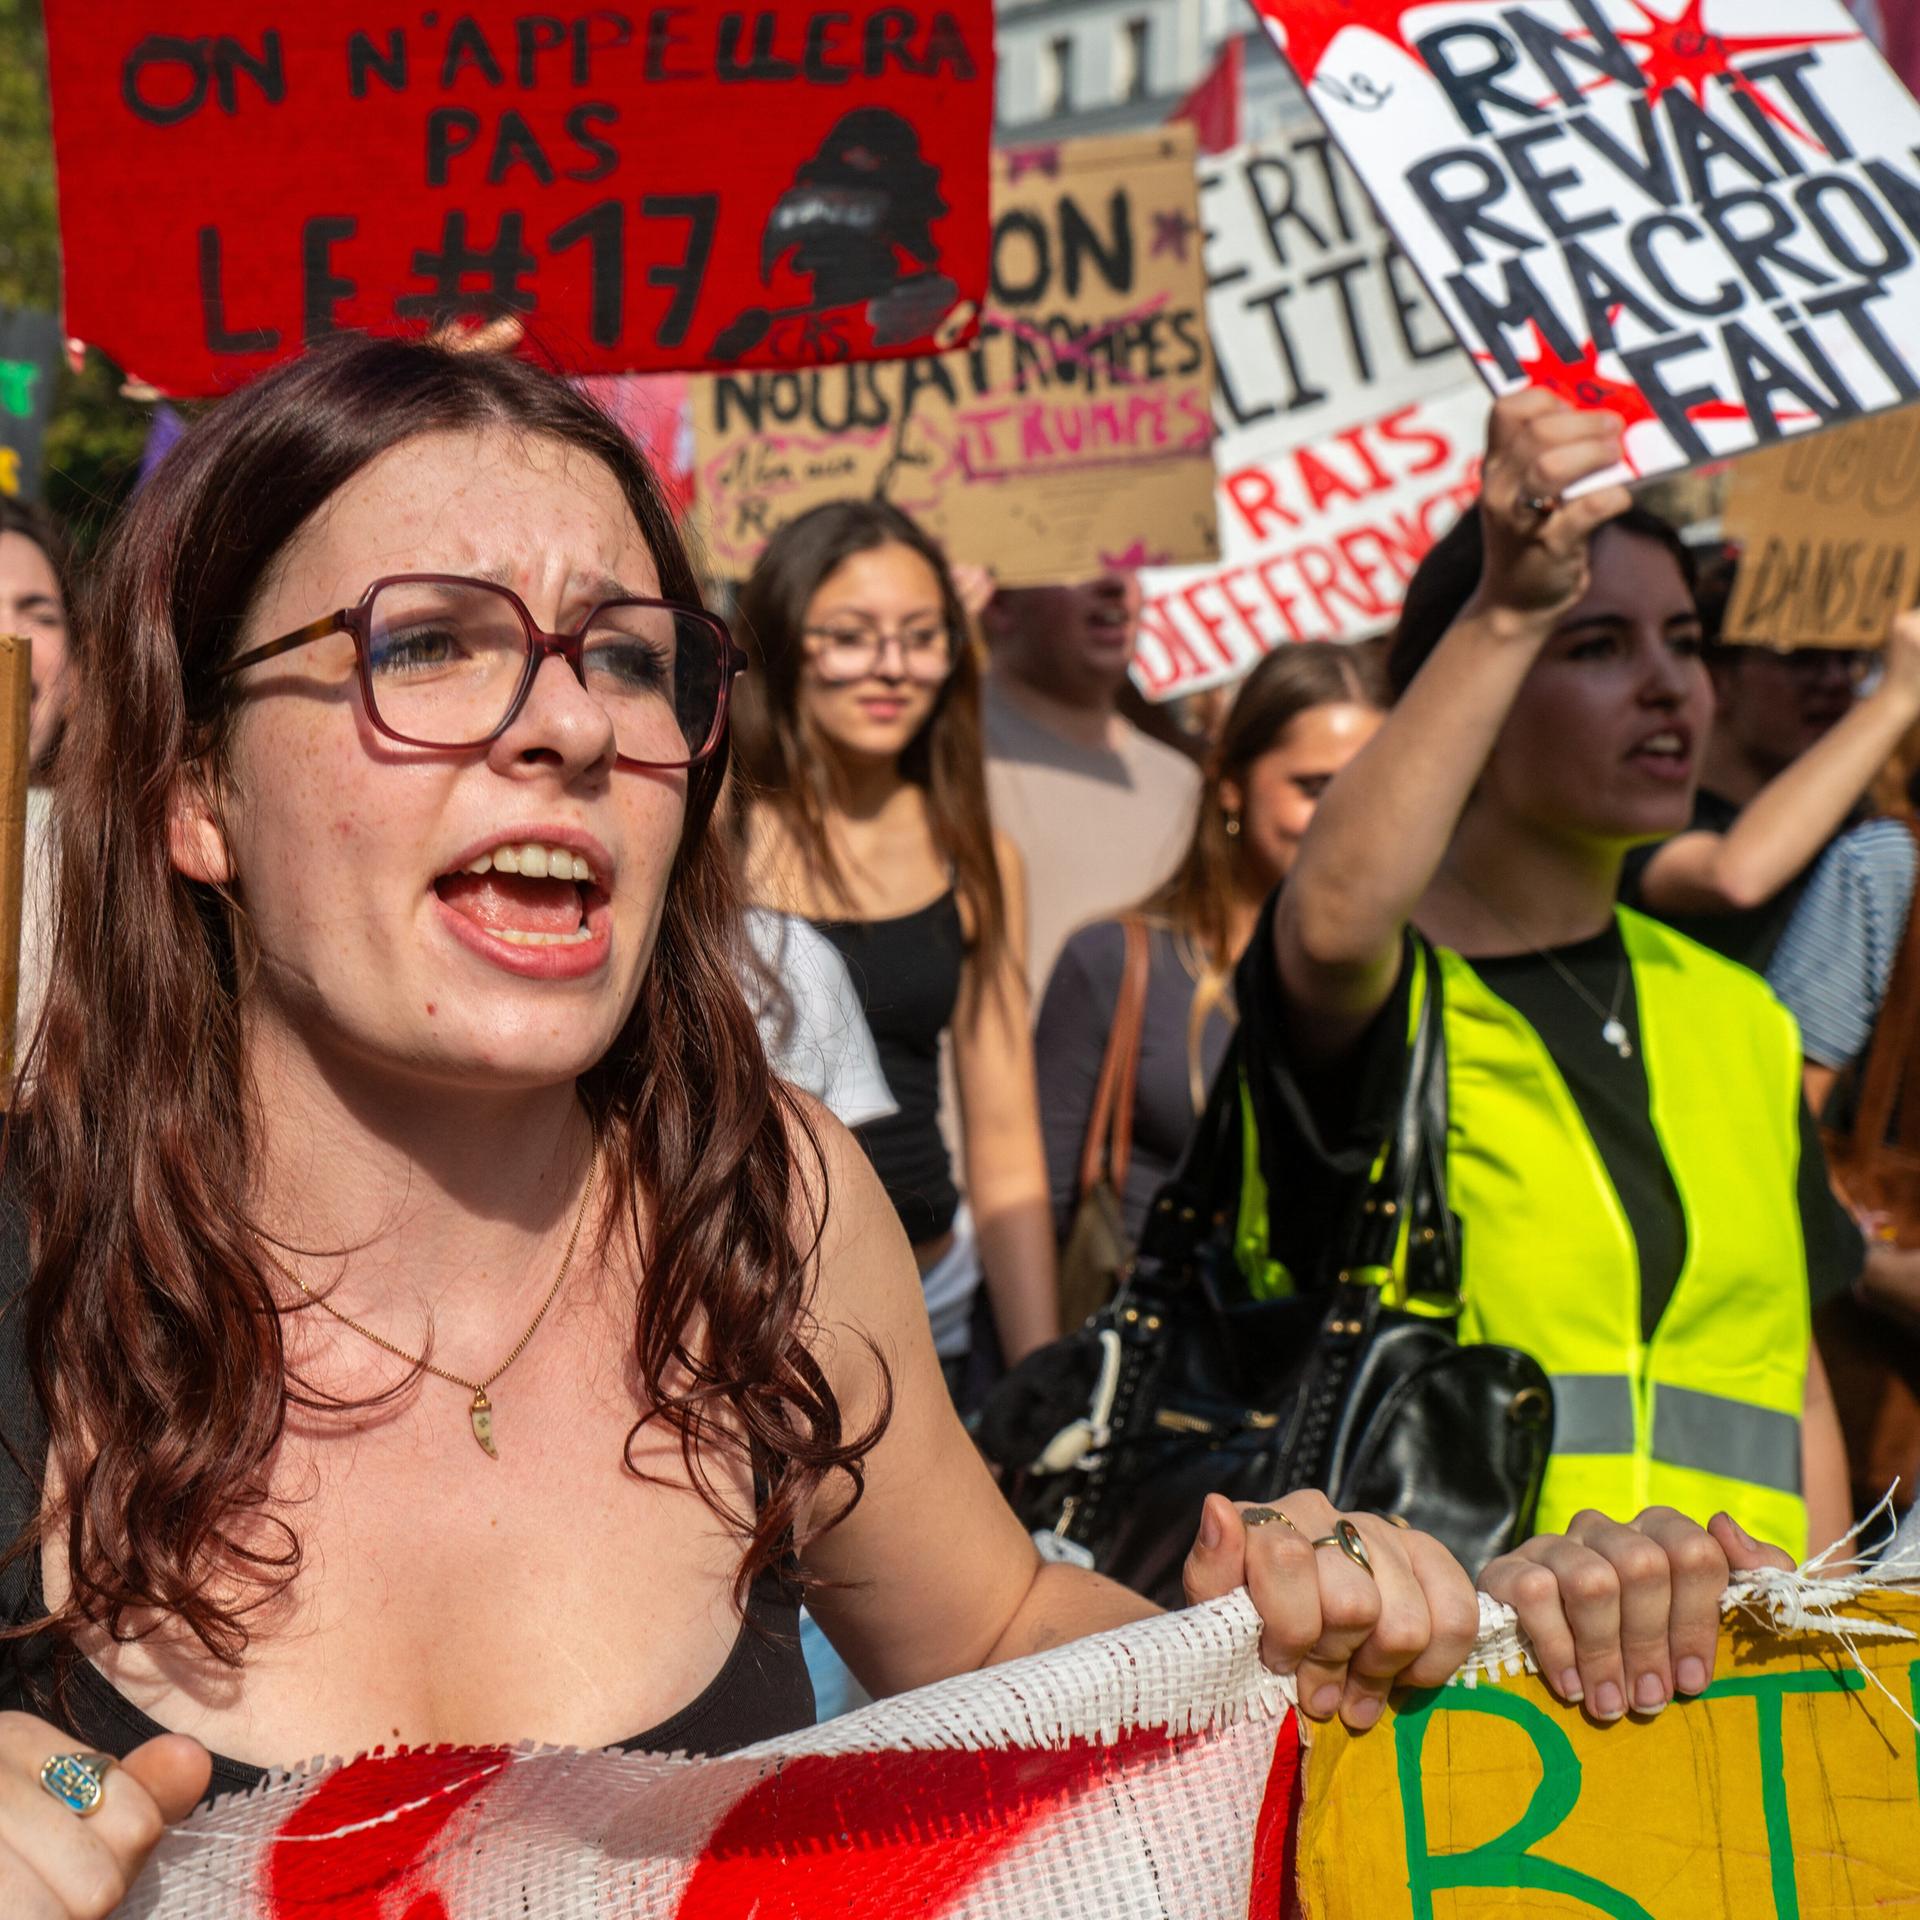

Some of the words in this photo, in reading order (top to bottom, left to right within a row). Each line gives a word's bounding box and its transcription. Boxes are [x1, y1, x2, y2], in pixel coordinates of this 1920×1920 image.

[121, 30, 284, 125] ON
[1415, 0, 1651, 138] RN
[427, 104, 621, 186] PAS
[200, 217, 357, 354] LE
[1442, 148, 1920, 382] MACRON
